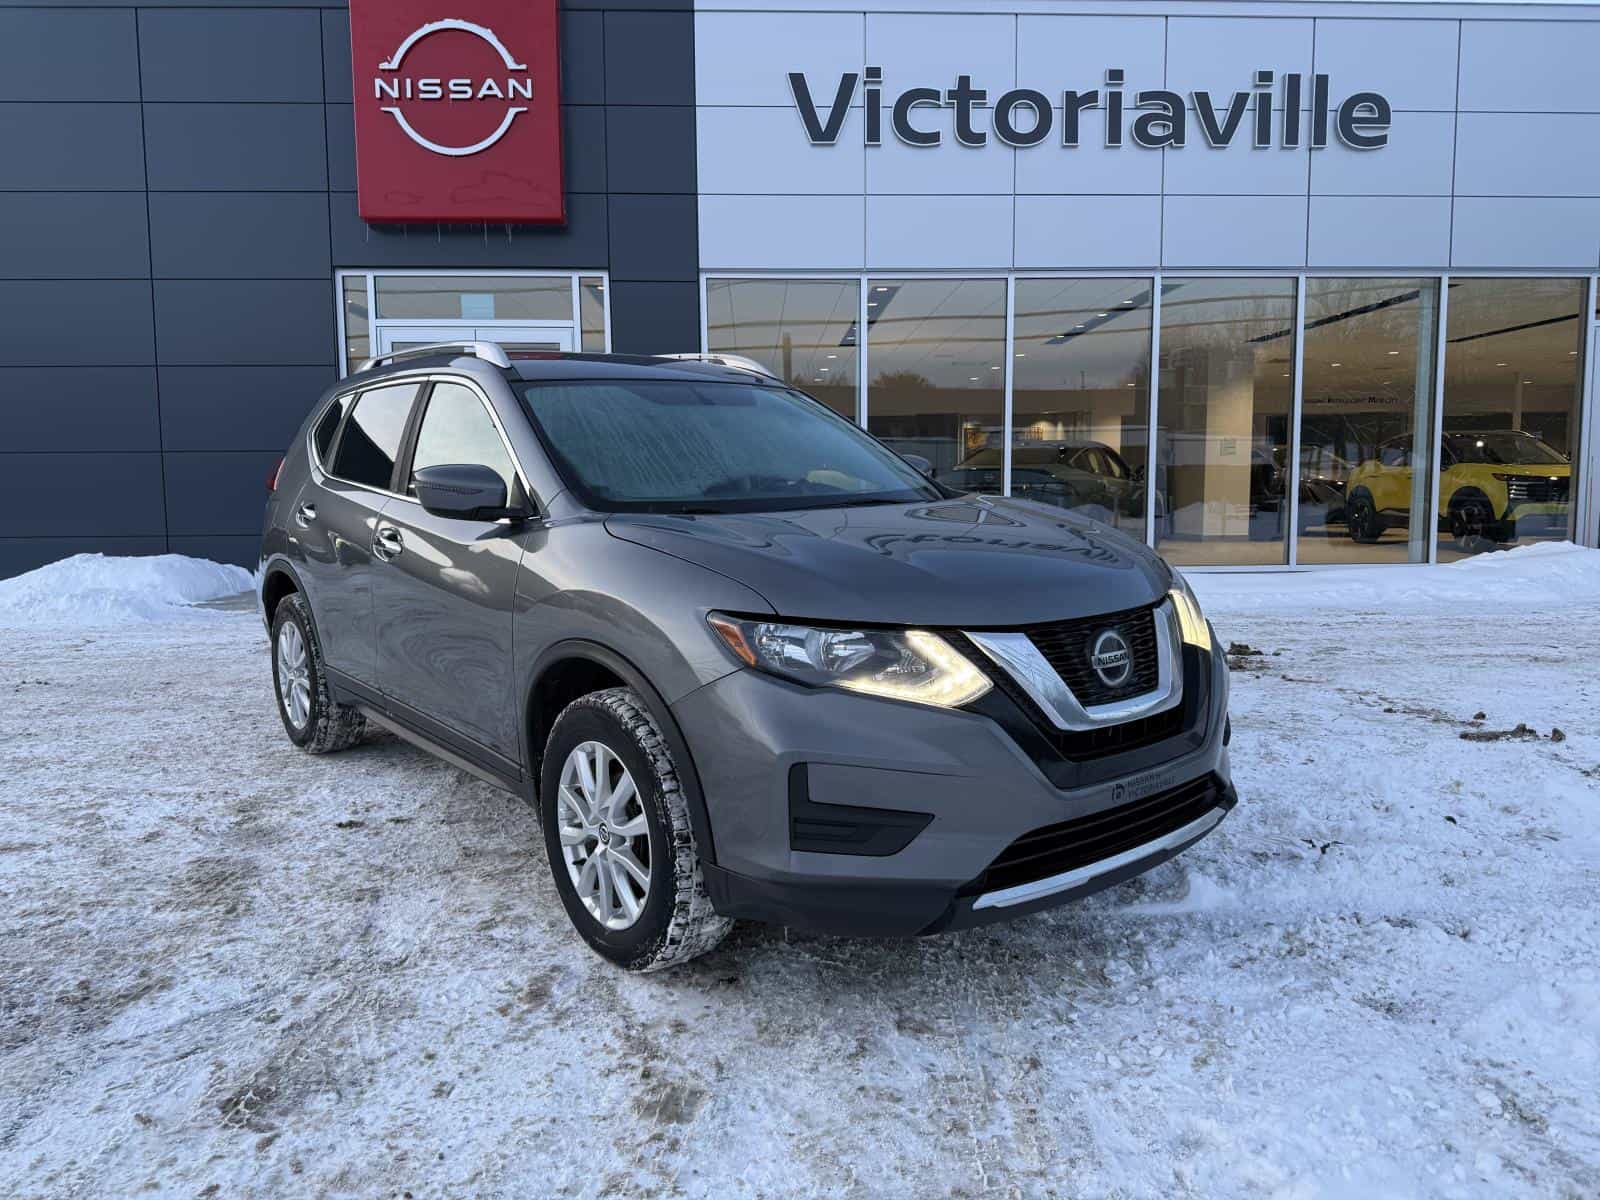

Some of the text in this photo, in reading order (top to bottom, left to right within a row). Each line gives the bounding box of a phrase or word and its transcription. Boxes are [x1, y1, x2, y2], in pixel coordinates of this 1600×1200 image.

[374, 78, 533, 99] NISSAN
[787, 66, 1392, 148] Victoriaville
[1097, 652, 1130, 666] NISSAN
